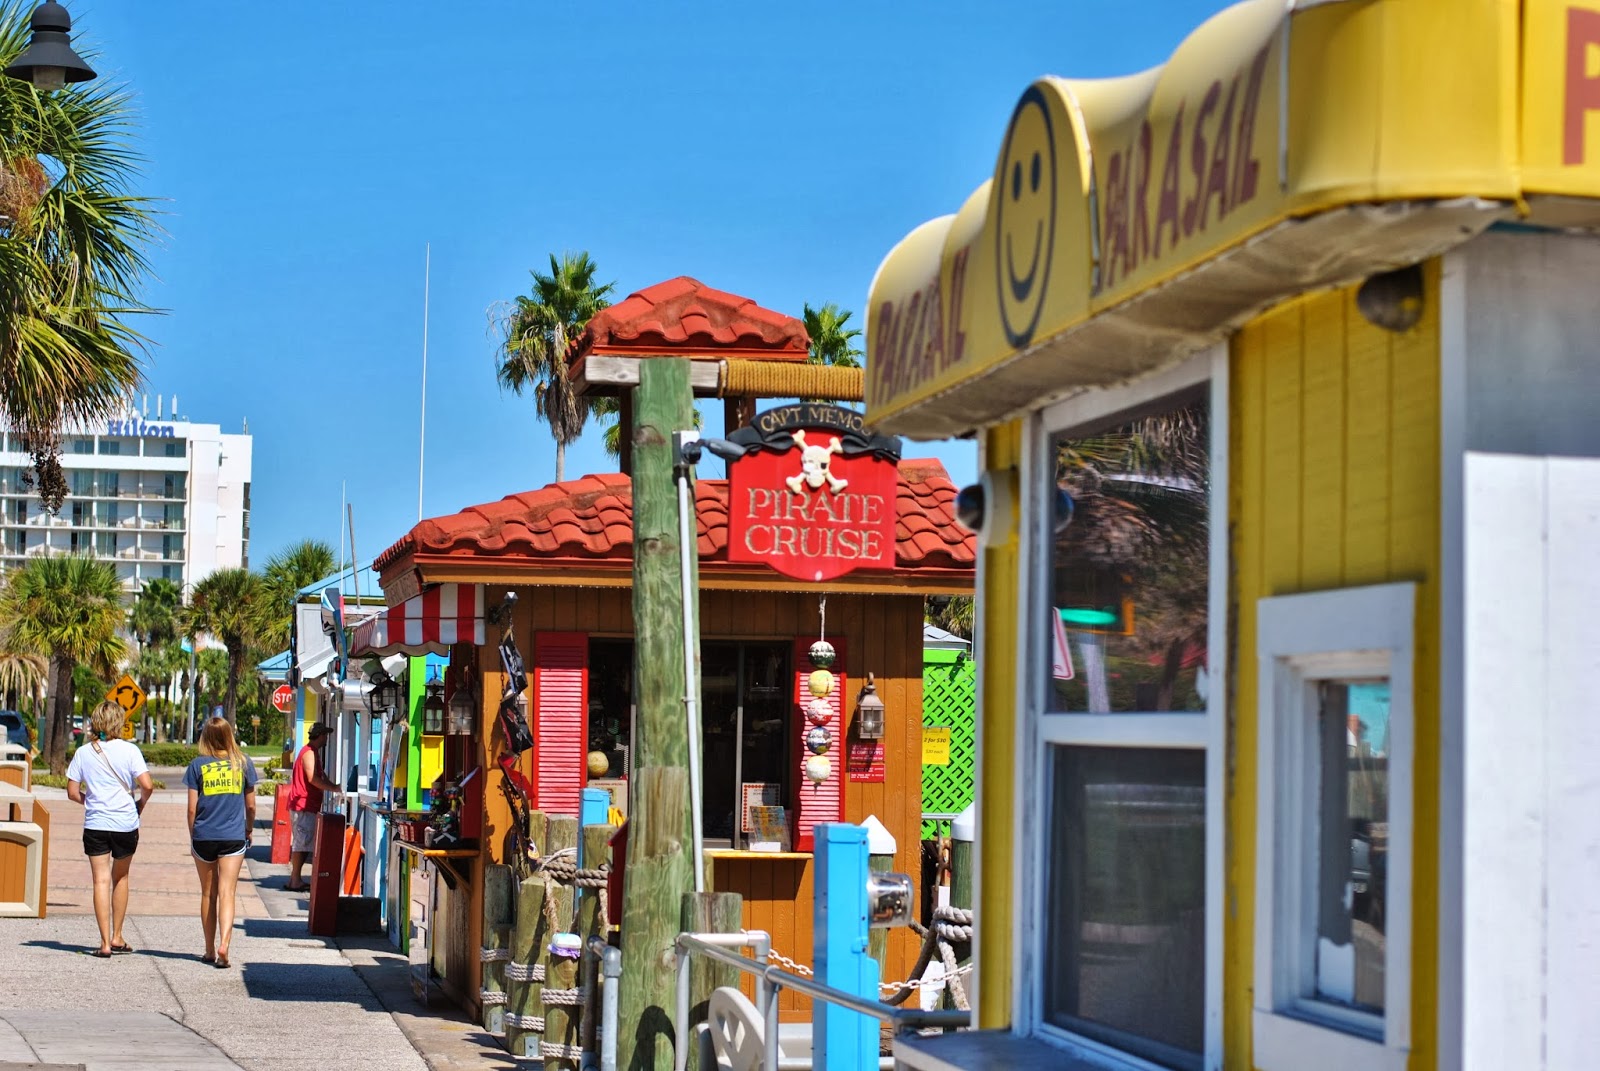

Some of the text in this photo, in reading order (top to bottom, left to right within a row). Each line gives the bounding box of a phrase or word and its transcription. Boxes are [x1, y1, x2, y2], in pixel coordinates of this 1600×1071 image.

[1097, 46, 1267, 294] PARASAIL
[107, 419, 176, 438] Hilton
[746, 488, 884, 525] PIRATE
[744, 524, 884, 560] CRUISE
[274, 692, 293, 704] STO
